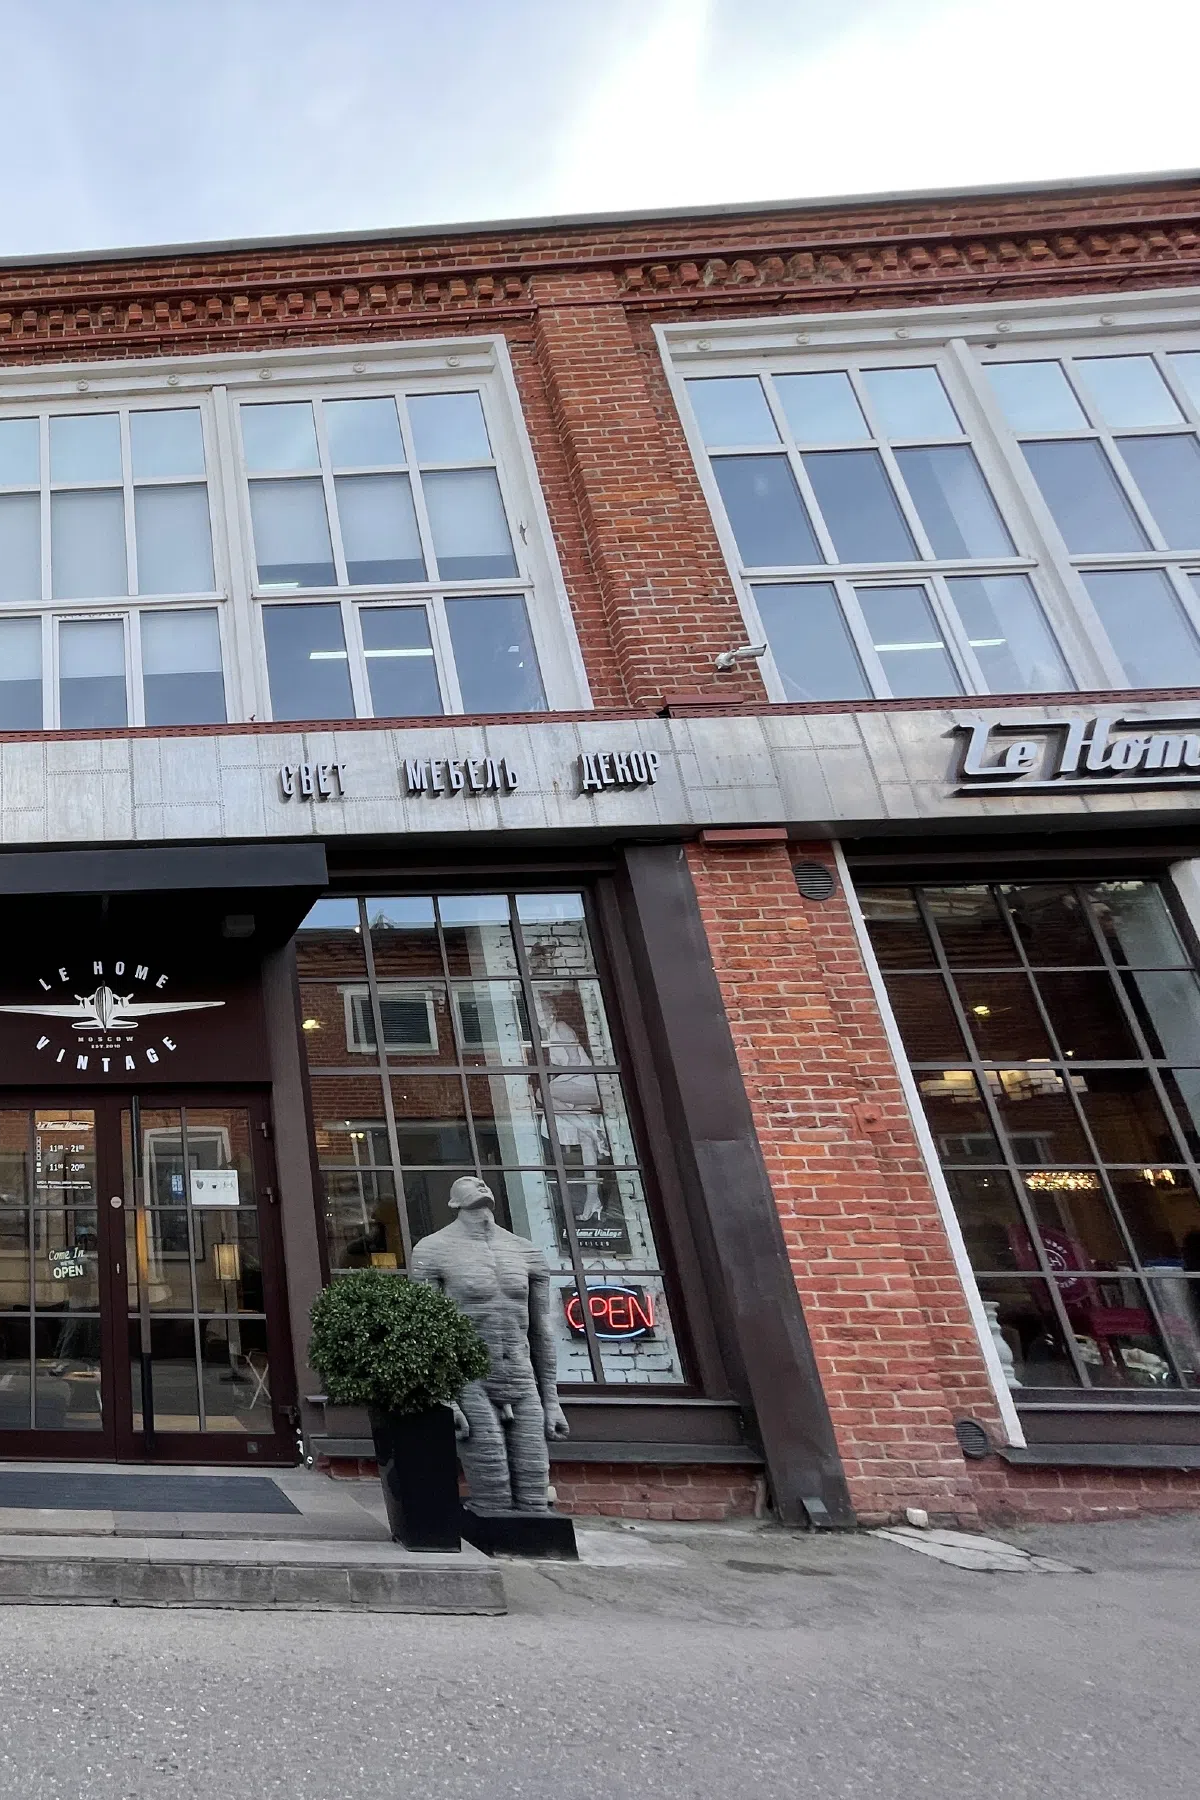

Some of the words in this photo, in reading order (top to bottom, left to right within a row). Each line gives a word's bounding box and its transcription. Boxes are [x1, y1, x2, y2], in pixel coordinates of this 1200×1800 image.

[960, 722, 1038, 774] Le
[1000, 717, 1200, 773] Hom
[280, 763, 346, 796] СВЕТ
[402, 757, 518, 794] МЕБЕЛЬ
[578, 750, 661, 793] ДЕКОР
[38, 967, 70, 991] LE
[92, 961, 169, 988] HOME
[36, 1035, 177, 1072] VINTAGE
[49, 1250, 71, 1261] Come
[73, 1247, 85, 1258] In
[53, 1265, 83, 1279] OPEN
[567, 1295, 655, 1329] OPEN
